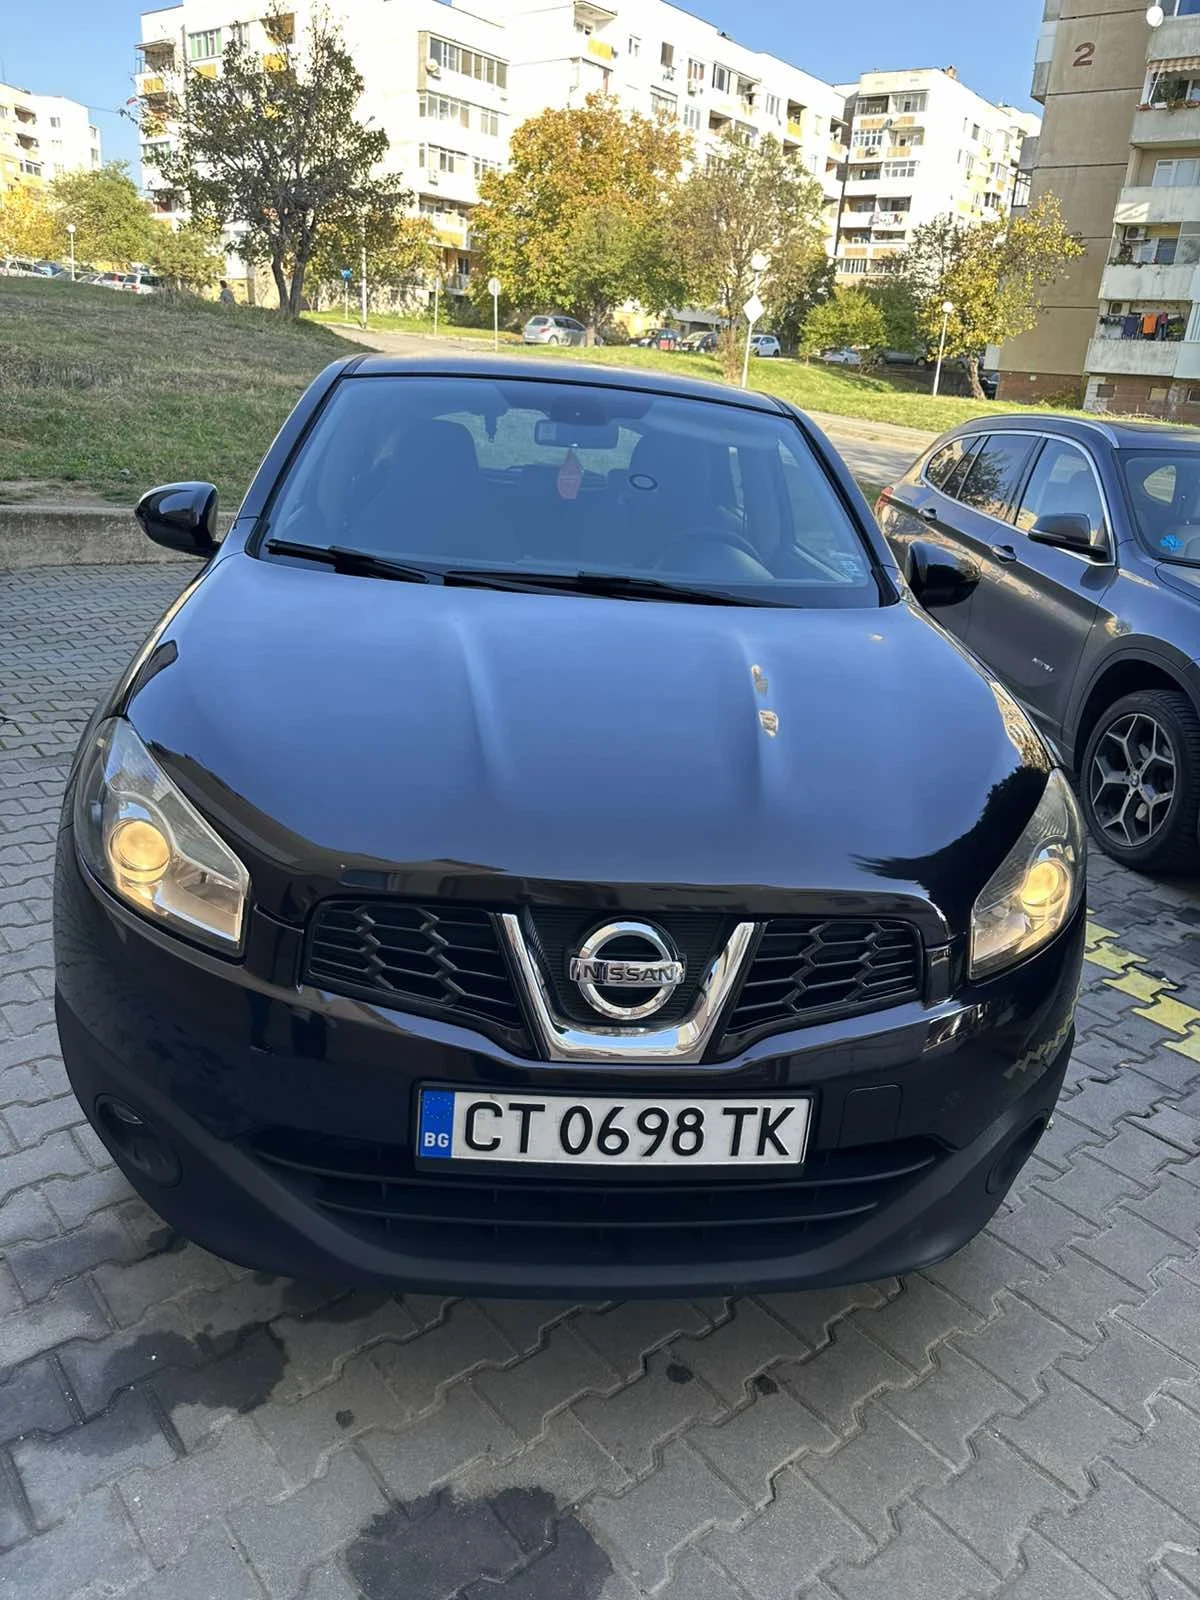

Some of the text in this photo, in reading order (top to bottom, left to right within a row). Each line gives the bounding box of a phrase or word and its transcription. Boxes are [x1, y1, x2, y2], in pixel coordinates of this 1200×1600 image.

[1072, 42, 1096, 67] 2
[583, 963, 674, 983] NISSAN
[423, 1132, 449, 1148] BG
[464, 1101, 795, 1158] CT 0698 TK
